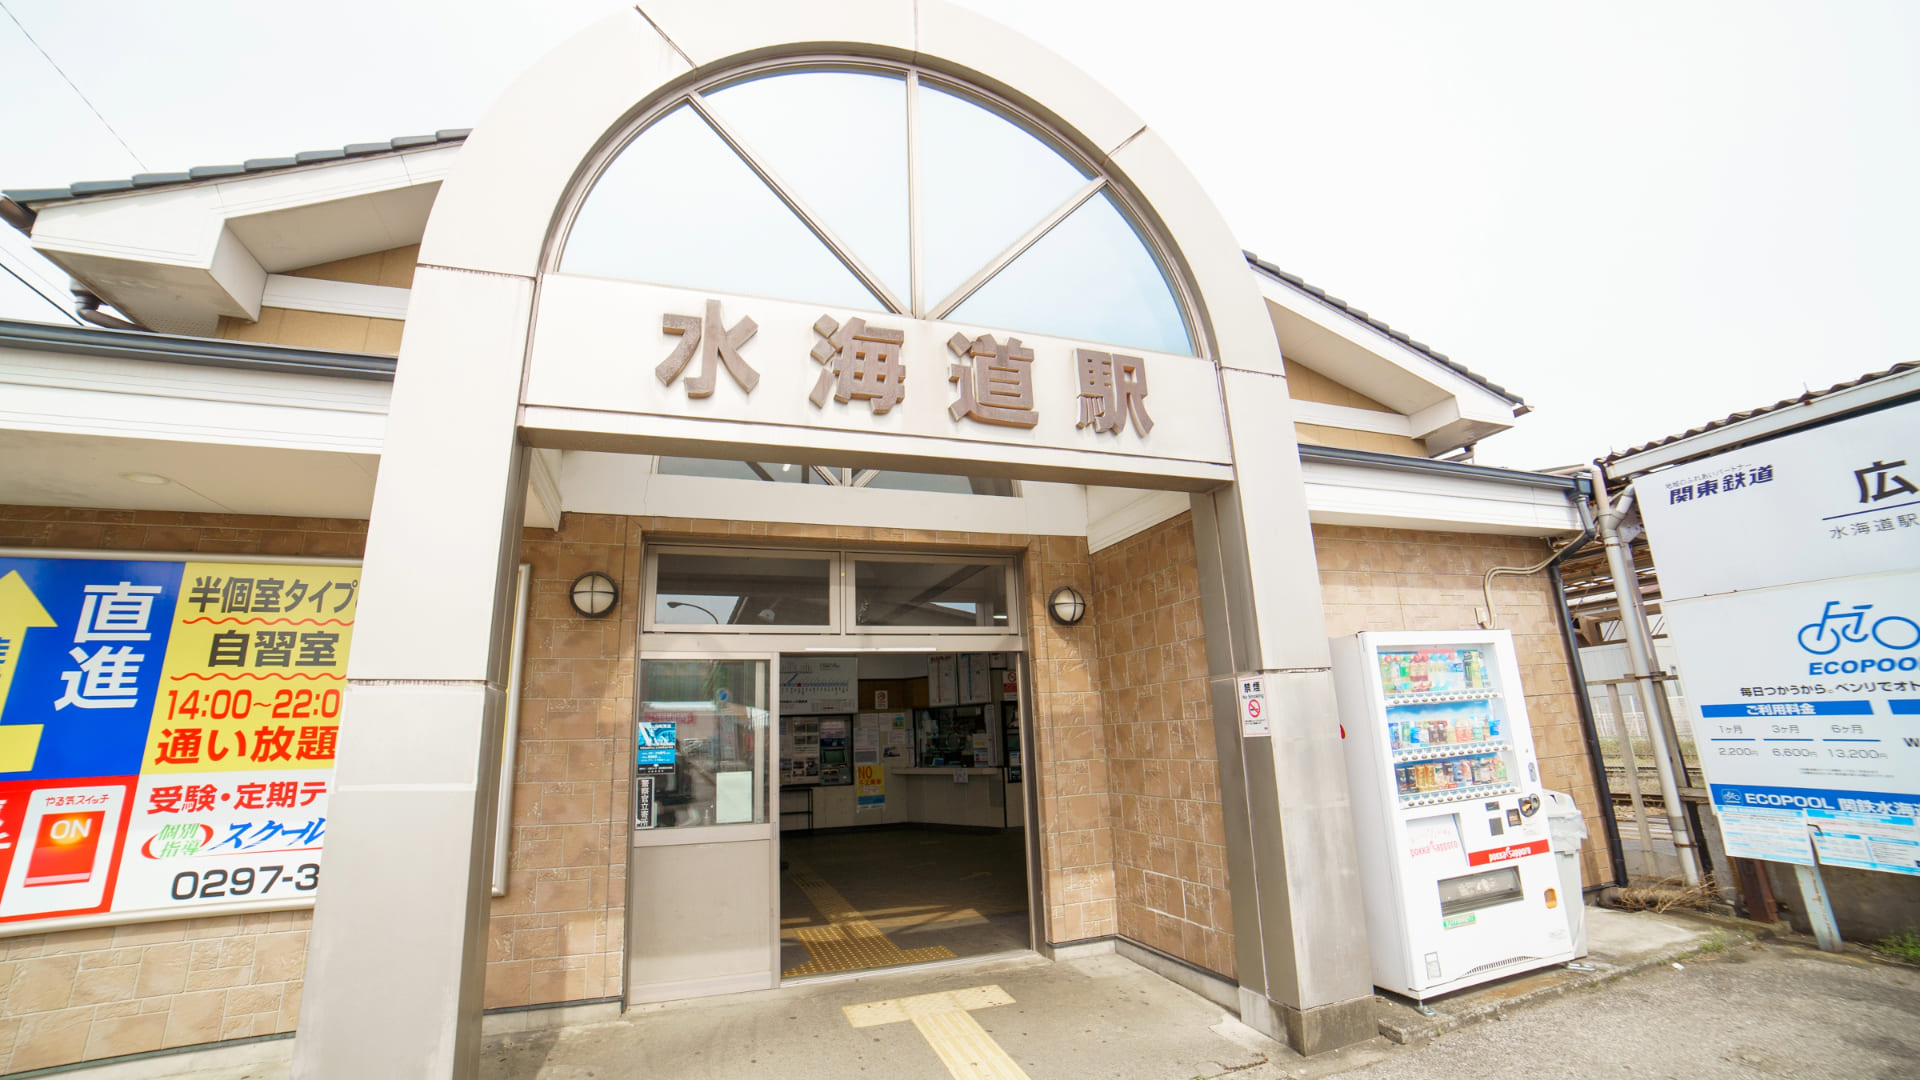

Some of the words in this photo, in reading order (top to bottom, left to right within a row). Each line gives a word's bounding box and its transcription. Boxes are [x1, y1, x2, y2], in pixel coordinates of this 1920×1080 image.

[655, 299, 1154, 439] 水海道駅
[1670, 464, 1773, 505] 関東鉄道
[188, 576, 358, 613] 半個室タイプ
[54, 581, 162, 711] 直進
[208, 630, 339, 667] 自習室
[1809, 656, 1920, 675] ECOPOO
[1746, 703, 1816, 716] ご利用料金
[154, 725, 339, 765] 通い放題
[45, 794, 110, 807] やる気スイッチ
[1745, 792, 1835, 810] ECOPOOL
[50, 818, 92, 839] ON
[158, 823, 201, 841] 個別
[208, 817, 326, 851] スクール
[160, 840, 202, 858] 指導
[171, 863, 320, 900] 0297-3
